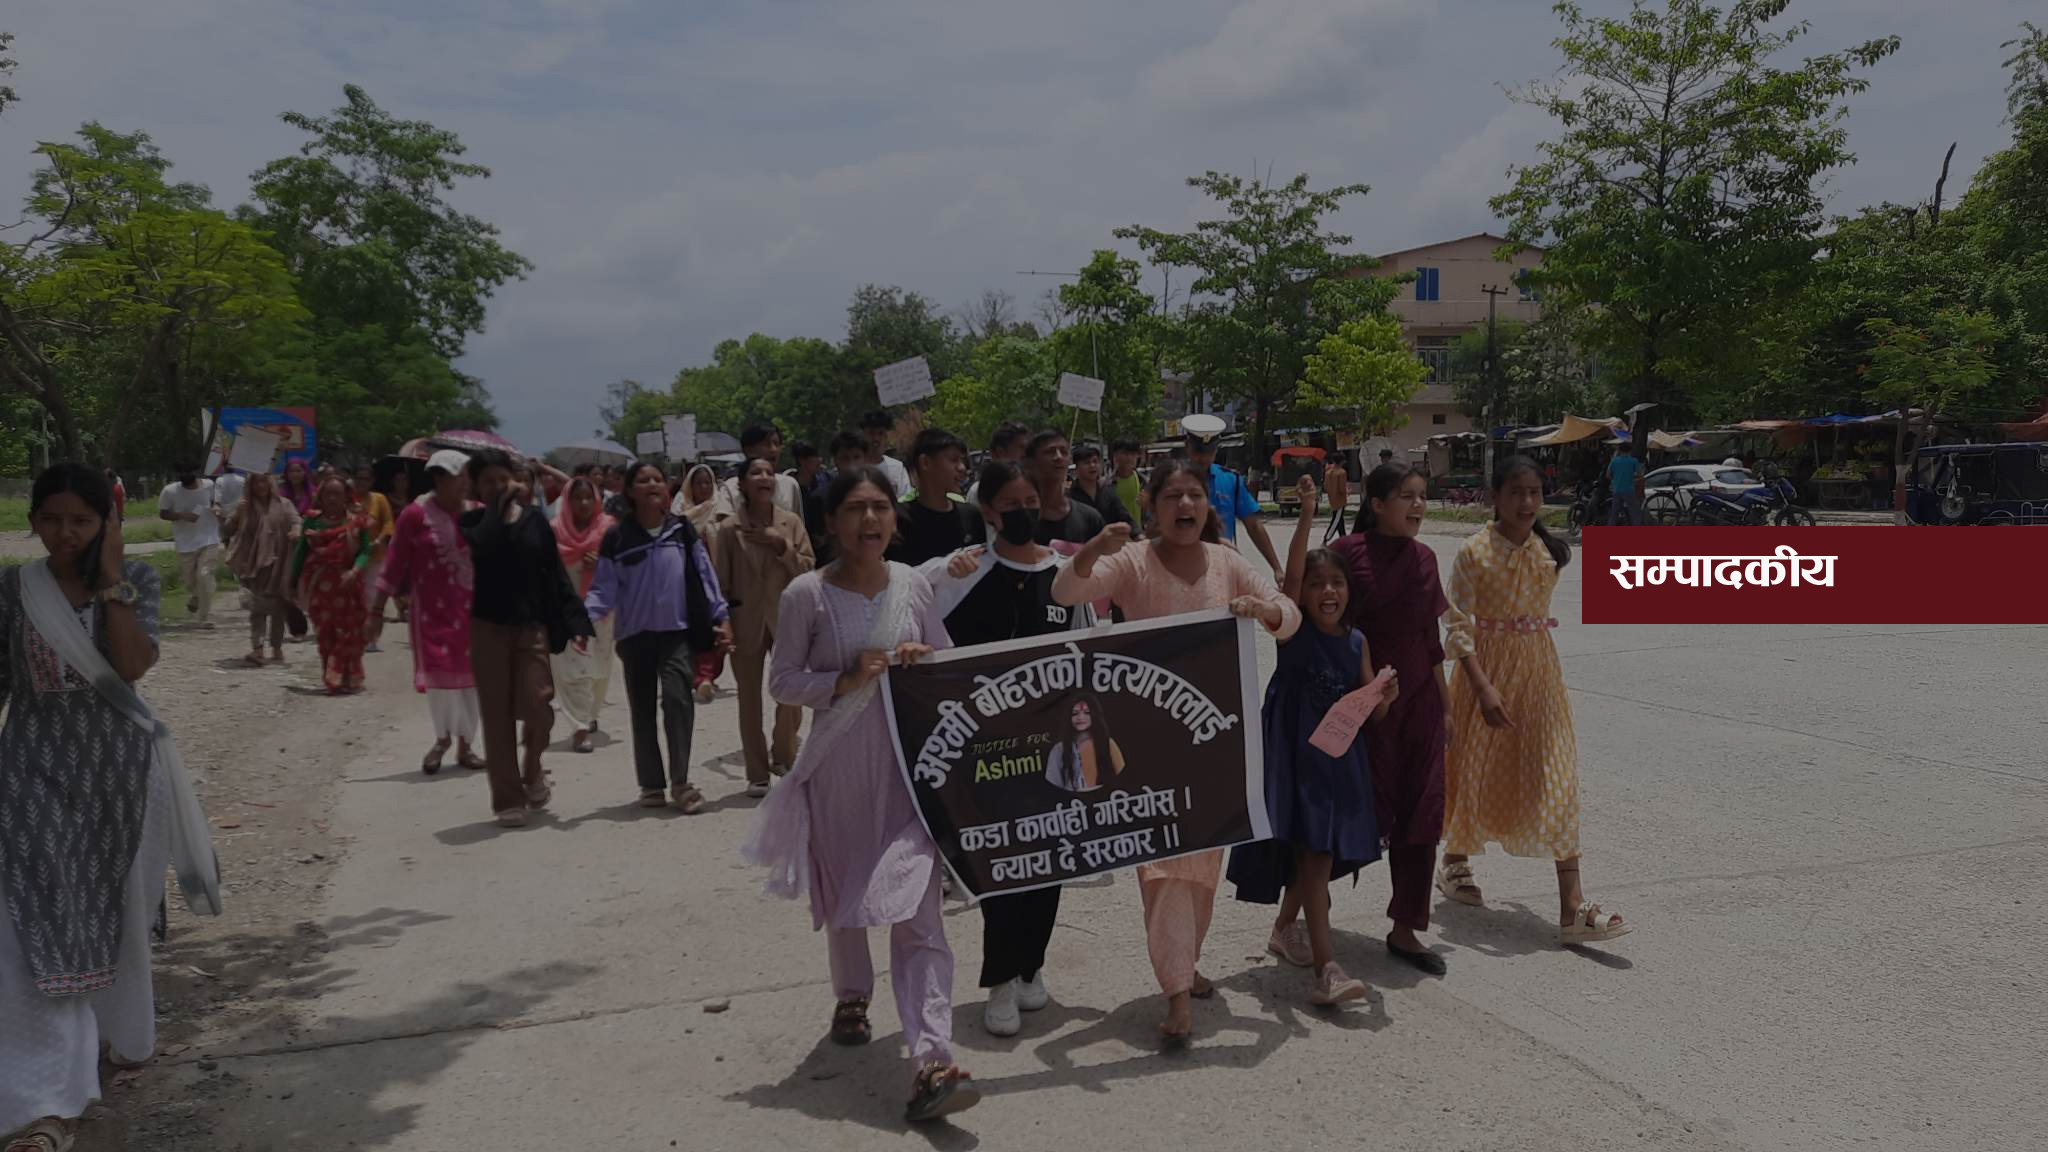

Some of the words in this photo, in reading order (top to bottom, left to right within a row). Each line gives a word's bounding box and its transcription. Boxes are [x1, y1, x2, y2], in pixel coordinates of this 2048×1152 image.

[1045, 604, 1067, 625] RD
[968, 642, 1085, 717] बोहराको
[1092, 651, 1239, 744] हत्यारालाई
[974, 749, 1042, 783] Ashmi
[959, 820, 1010, 851] कडा
[990, 850, 1053, 883] न्याय
[1057, 838, 1076, 872] दे
[1080, 828, 1157, 868] सरकार
